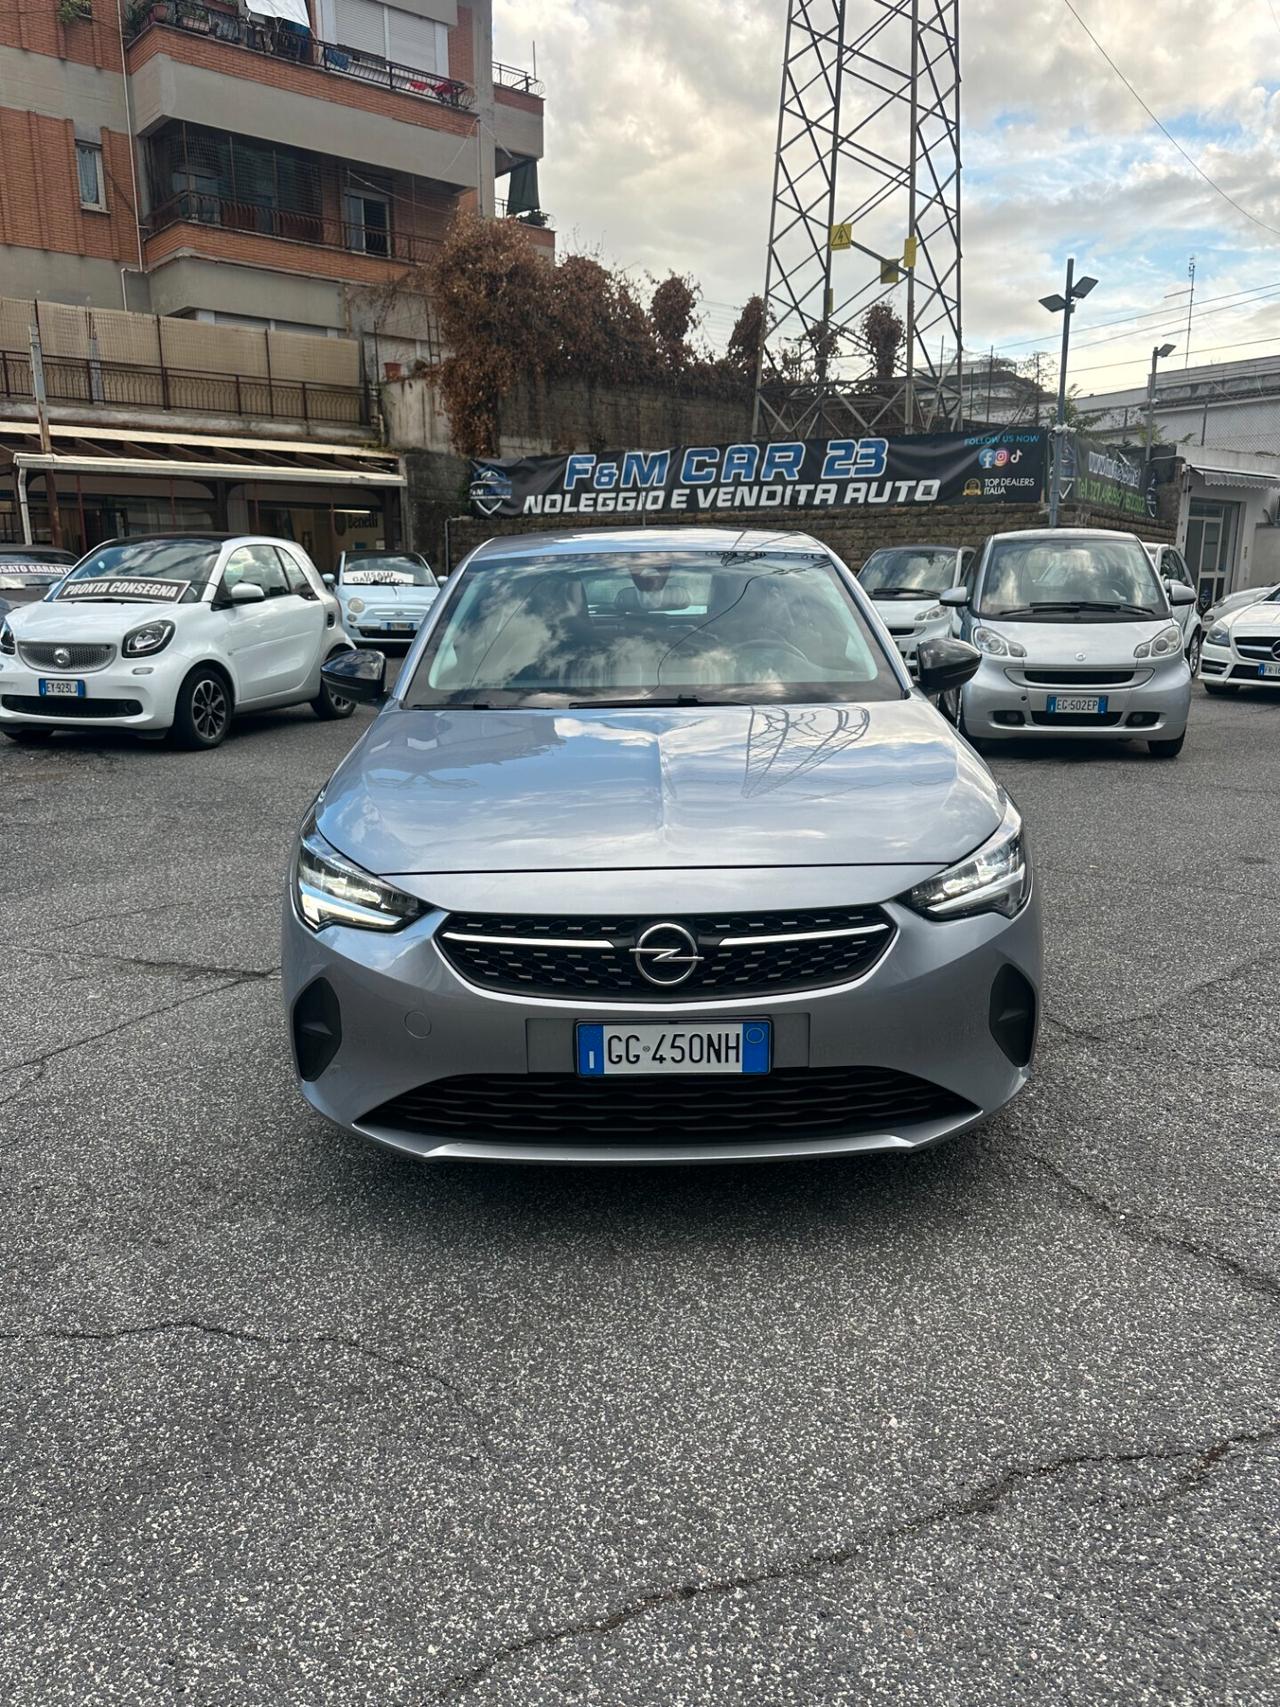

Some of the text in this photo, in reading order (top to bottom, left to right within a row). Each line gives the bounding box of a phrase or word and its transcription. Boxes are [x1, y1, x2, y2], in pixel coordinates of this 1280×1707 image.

[964, 434, 1040, 446] FOLLOW US NOW
[563, 437, 890, 490] F&M CAR 23
[983, 477, 1035, 487] TOP DEALERS
[522, 479, 942, 515] NOLEGGIO E VENDITA AUTO
[983, 486, 1007, 495] ITALIA
[63, 581, 179, 598] PRONTA CONSEGNA
